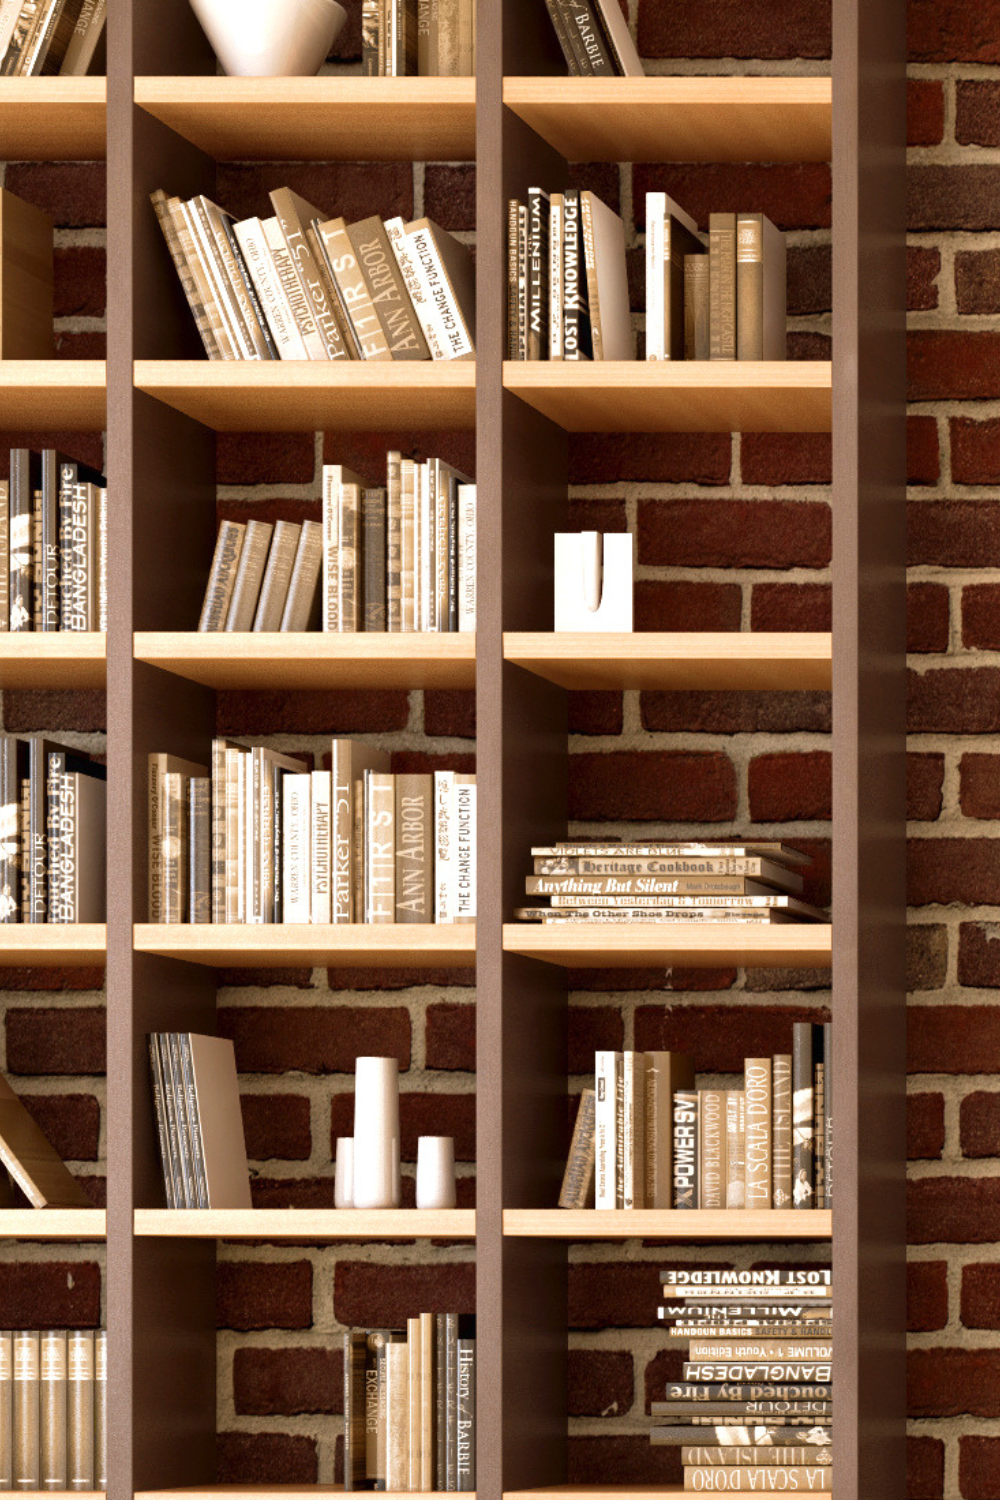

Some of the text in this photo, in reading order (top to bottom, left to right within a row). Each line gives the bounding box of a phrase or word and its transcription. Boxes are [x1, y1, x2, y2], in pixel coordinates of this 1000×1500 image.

[575, 13, 604, 69] BARBIE
[509, 200, 517, 247] HANDGUN
[509, 248, 517, 283] BASICS
[530, 197, 541, 333] MILLENIUM
[564, 197, 579, 361] LOST KNOWLEDGE
[271, 247, 317, 337] PSYCHOTHERAPY
[359, 237, 420, 352] ANN ARBOR
[414, 234, 464, 353] THE CHANGE FUNCTION
[307, 280, 345, 360] Parker
[466, 502, 475, 528] OHIO
[72, 484, 87, 631] BANGLADESH
[327, 546, 339, 580] WISE
[46, 543, 59, 625] DETOUR
[327, 583, 339, 631] BLOOD
[466, 573, 475, 615] WARREN
[59, 774, 74, 921] BANGLADESH
[396, 795, 425, 914] ANN ARBOR
[458, 788, 471, 913] THE CHANGE FUNCTION
[582, 860, 713, 874] Heritage Cookbook
[34, 832, 47, 914] DETOUR
[152, 871, 161, 919] BLOOD
[336, 834, 350, 919] Parker
[533, 878, 679, 896] Anything But Silent
[525, 910, 562, 918] When
[565, 910, 589, 918] The
[592, 910, 629, 918] Other
[632, 910, 663, 918] Shoe
[665, 910, 704, 919] Drops
[692, 896, 754, 905] Tomorrow
[774, 1060, 792, 1131] ISLAND
[705, 1094, 721, 1208] DAVID BLACKWOOD
[746, 1065, 768, 1199] LA SCALA D'ORO
[668, 1269, 831, 1286] LOST KNOWLEDGE
[667, 1306, 803, 1317] MILLENIUM
[671, 1328, 716, 1336] HANDGUN
[719, 1328, 753, 1336] BASICS
[755, 1328, 788, 1336] SAFETY
[456, 1349, 474, 1400] History
[686, 1366, 832, 1382] BANGLADESH
[695, 1346, 732, 1358] Edition
[735, 1346, 767, 1358] Youth
[366, 1369, 378, 1434] EXCHANGE
[669, 1384, 831, 1401] ouched By Fire
[746, 1401, 827, 1412] DETOUR
[457, 1420, 473, 1475] BARBIE
[687, 1446, 758, 1465] ISLAND
[691, 1468, 826, 1491] LA SCALA D'ORO
